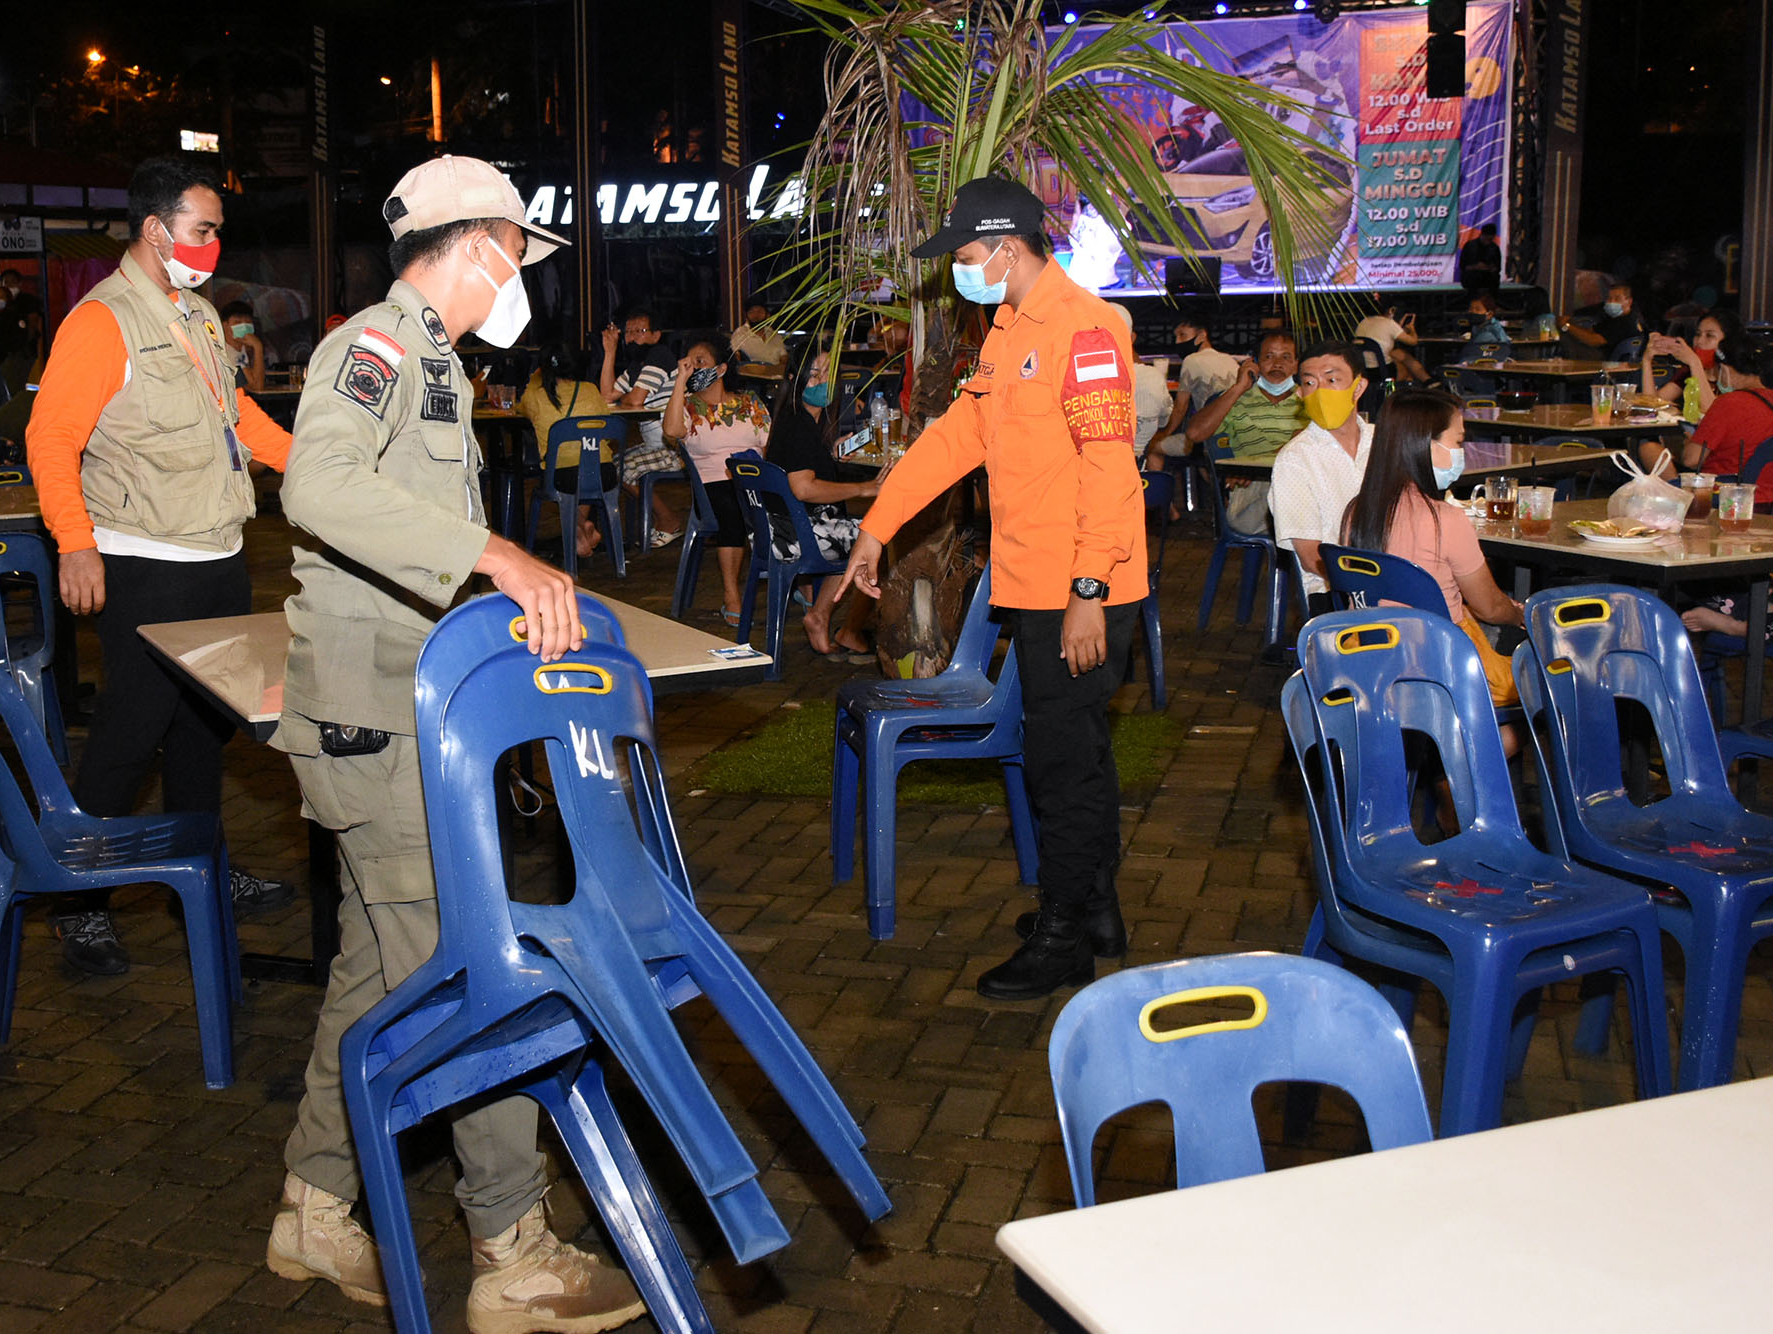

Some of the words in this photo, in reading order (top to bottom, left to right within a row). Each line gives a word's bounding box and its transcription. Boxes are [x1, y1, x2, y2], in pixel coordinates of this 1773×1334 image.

[310, 25, 327, 73] LAND
[719, 21, 738, 73] LAND
[1370, 72, 1427, 91] KAM
[1553, 27, 1581, 134] KATAMSO
[1369, 93, 1411, 107] 12.00
[312, 76, 328, 162] KATAMSO
[722, 75, 740, 168] KATAMSO
[1397, 106, 1421, 119] s.d
[1365, 122, 1400, 135] Last
[1405, 119, 1454, 132] Order
[1372, 148, 1447, 168] JUMAT
[1365, 181, 1453, 200] MINGGU
[1366, 207, 1409, 221] 12.00
[1414, 205, 1449, 219] WIB
[1396, 220, 1419, 233] s.d
[1367, 235, 1408, 248] 17.00
[1413, 233, 1448, 246] WIB
[1368, 270, 1405, 278] Minimal
[582, 436, 599, 451] KL
[746, 489, 763, 508] KL
[569, 720, 614, 780] KL
